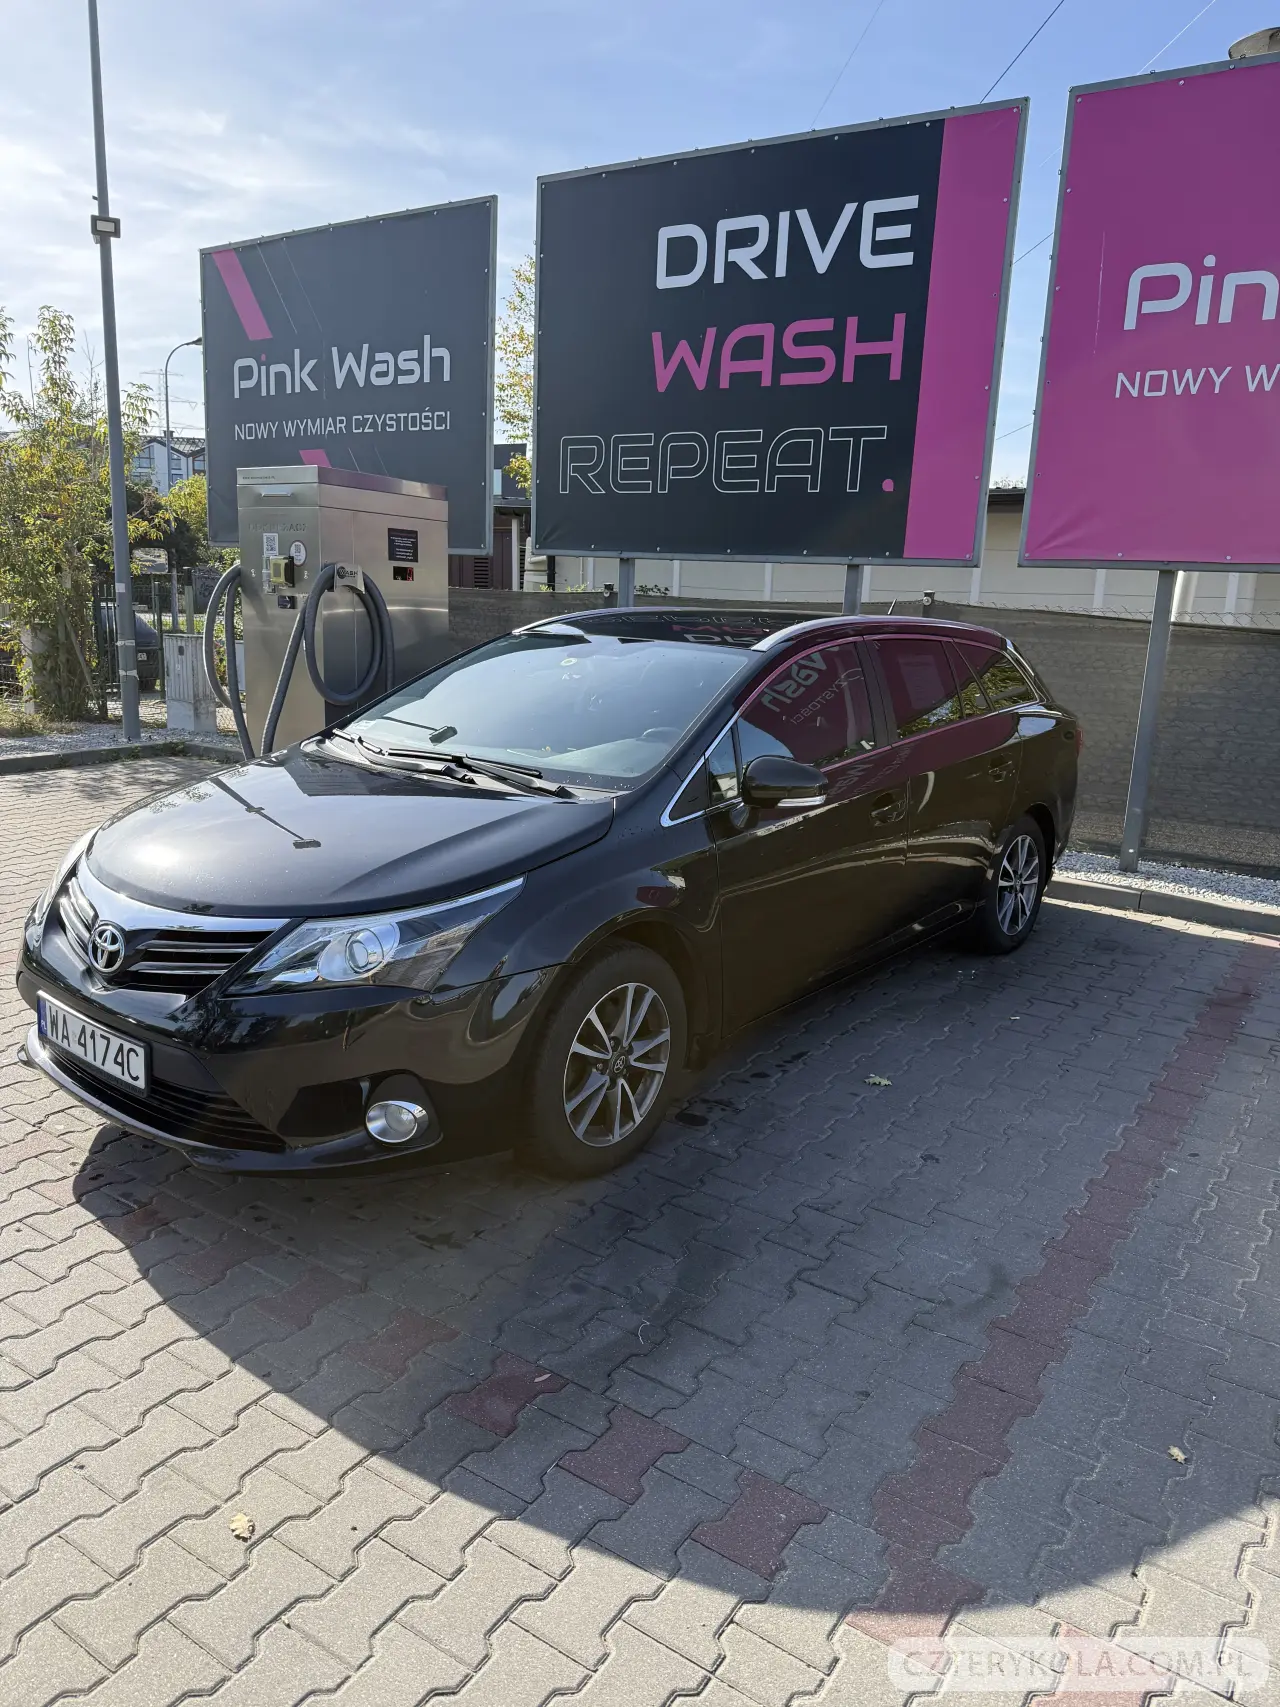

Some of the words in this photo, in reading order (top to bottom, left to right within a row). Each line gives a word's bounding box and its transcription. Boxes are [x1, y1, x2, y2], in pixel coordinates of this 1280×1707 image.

[656, 194, 919, 290] DRIVE
[1123, 254, 1280, 331] Pin
[233, 348, 319, 399] Pink
[331, 334, 451, 390] Wash
[651, 312, 906, 393] WASH
[1115, 366, 1233, 399] NOWY
[234, 421, 279, 441] NOWY
[282, 416, 347, 439] WYMIAR
[352, 406, 451, 434] CZYSTOŚCI
[559, 425, 895, 494] REPEAT.
[48, 1005, 71, 1048] WA
[77, 1024, 140, 1082] 4174C
